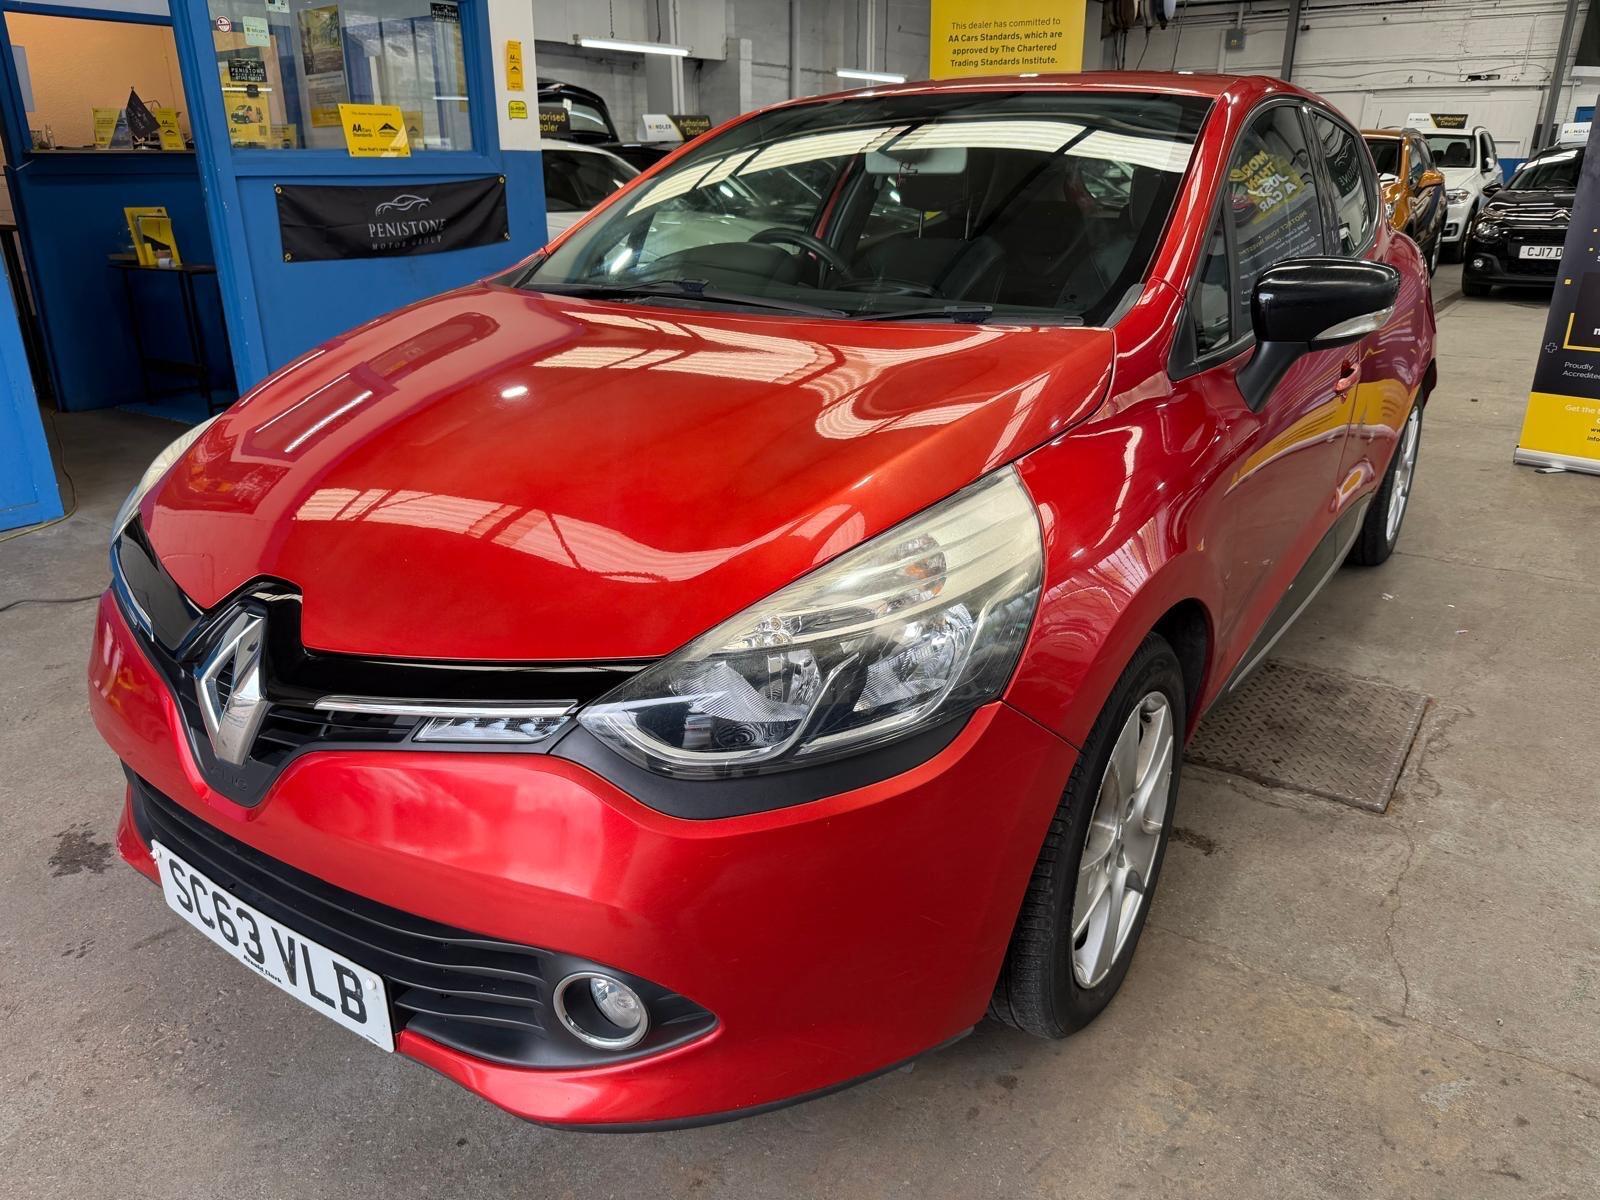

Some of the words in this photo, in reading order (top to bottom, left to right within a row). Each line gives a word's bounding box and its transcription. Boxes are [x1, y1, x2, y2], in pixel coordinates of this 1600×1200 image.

[952, 22, 967, 30] This
[968, 21, 992, 29] dealer
[993, 20, 1007, 28] has
[1008, 19, 1051, 27] committed
[948, 34, 960, 43] AA
[960, 33, 979, 42] Cars
[980, 32, 1023, 41] Standards,
[1024, 31, 1048, 39] which
[1049, 30, 1063, 38] are
[952, 46, 988, 55] approved
[989, 45, 1000, 54] by
[1000, 44, 1016, 52] The
[1016, 43, 1057, 52] Chartered
[950, 59, 979, 68] Trading
[980, 58, 1021, 66] Standards
[1022, 56, 1058, 64] Institute.
[368, 218, 447, 238] PENISTONE
[1526, 247, 1552, 257] CJ17
[1564, 361, 1594, 371] Proudly
[169, 858, 265, 965] SC63
[271, 925, 368, 1025] VLB
